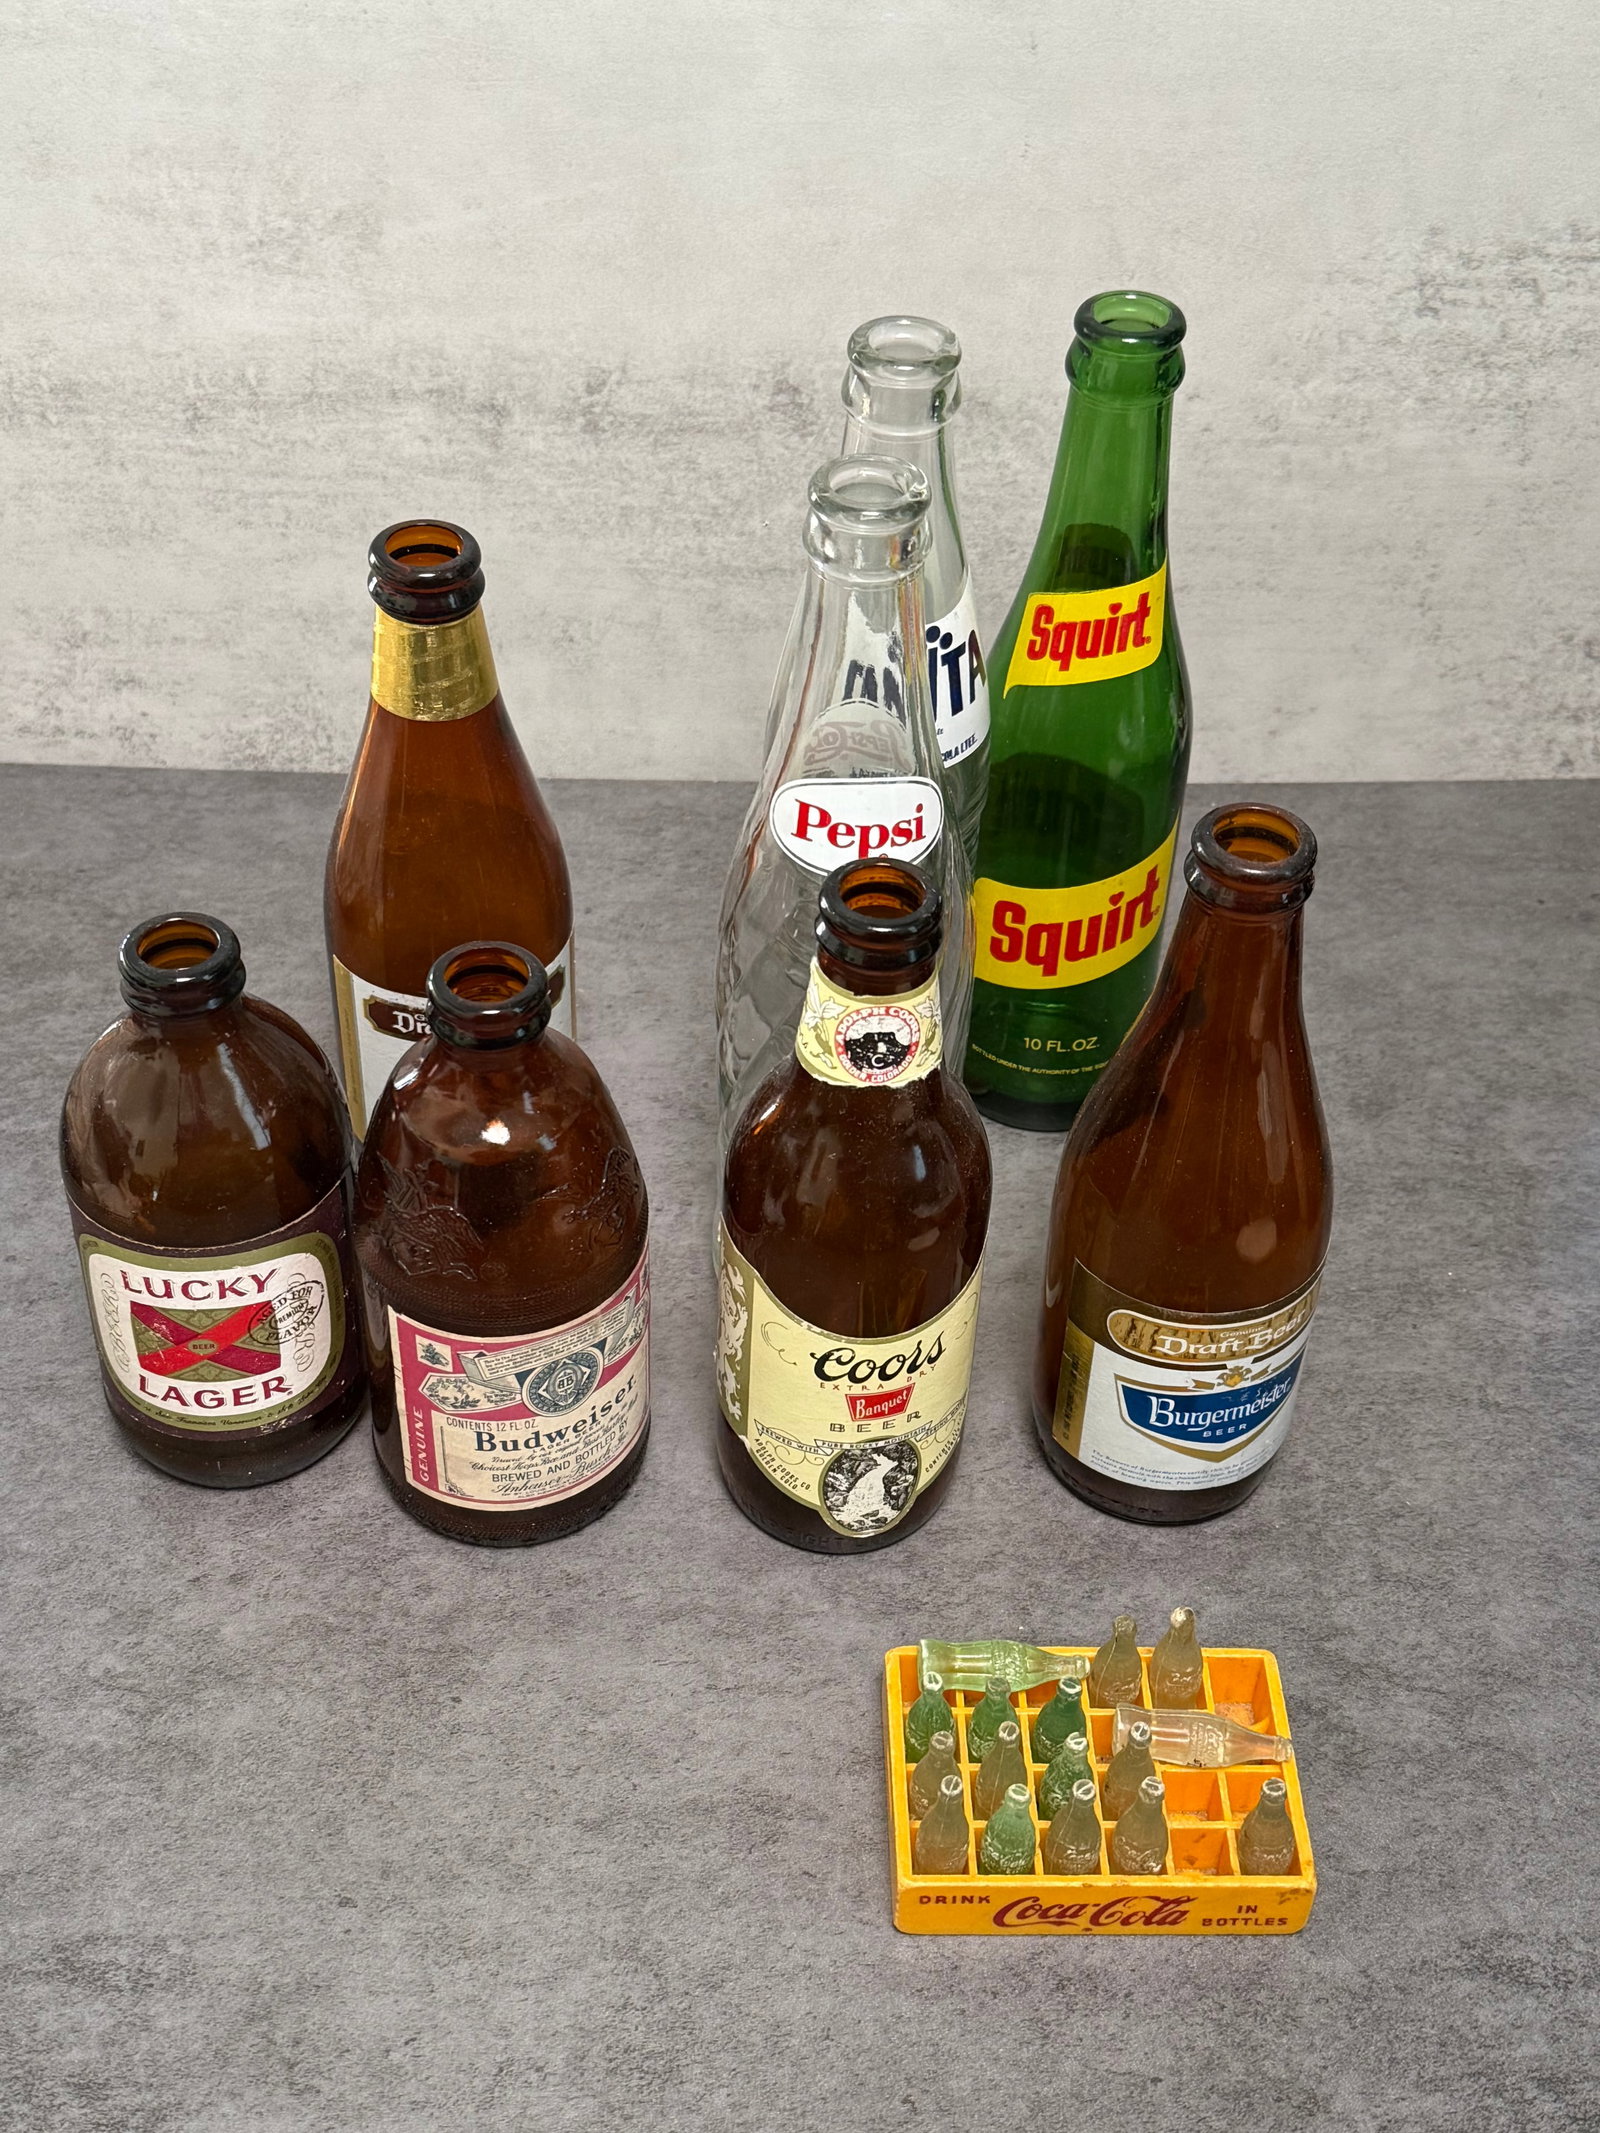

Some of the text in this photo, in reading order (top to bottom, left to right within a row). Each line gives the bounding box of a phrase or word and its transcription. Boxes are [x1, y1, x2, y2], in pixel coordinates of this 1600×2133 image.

[1027, 592, 1151, 672] Squirt
[791, 798, 926, 858] Pepsi
[990, 864, 1160, 976] Squirt
[393, 1011, 431, 1034] Dra
[836, 1007, 920, 1046] ADOLPH COORS
[1024, 1038, 1042, 1051] 10
[1018, 1064, 1031, 1073] THE
[120, 1267, 280, 1301] LUCKY
[290, 1285, 313, 1300] FOR
[1152, 1311, 1306, 1355] Draft Beer
[1220, 1326, 1265, 1338] Genuine
[809, 1331, 946, 1384] Coors
[138, 1375, 293, 1409] LAGER
[820, 1364, 936, 1391] EXTRA DRY
[855, 1389, 908, 1419] Banquet
[1146, 1377, 1292, 1432] Burgermeister
[446, 1416, 492, 1432] CONTENTS
[497, 1422, 507, 1432] 12
[830, 1411, 921, 1433] BEER
[1202, 1423, 1247, 1438] BEER
[412, 1406, 430, 1482] GENUINE
[492, 1469, 542, 1483] BREWED
[547, 1460, 571, 1475] AND
[575, 1431, 616, 1463] BOTTLED
[619, 1418, 629, 1435] BY
[761, 1426, 793, 1446] BREWED
[796, 1443, 819, 1453] WITH
[884, 1426, 927, 1444] MOUNTAIN
[754, 1438, 776, 1463] ADOLPH
[776, 1464, 799, 1483] COORS
[918, 1895, 991, 1905] DRINK
[993, 1895, 1199, 1928] Coca-Cola
[1237, 1905, 1258, 1914] IN
[1201, 1917, 1289, 1927] BOTTLES
